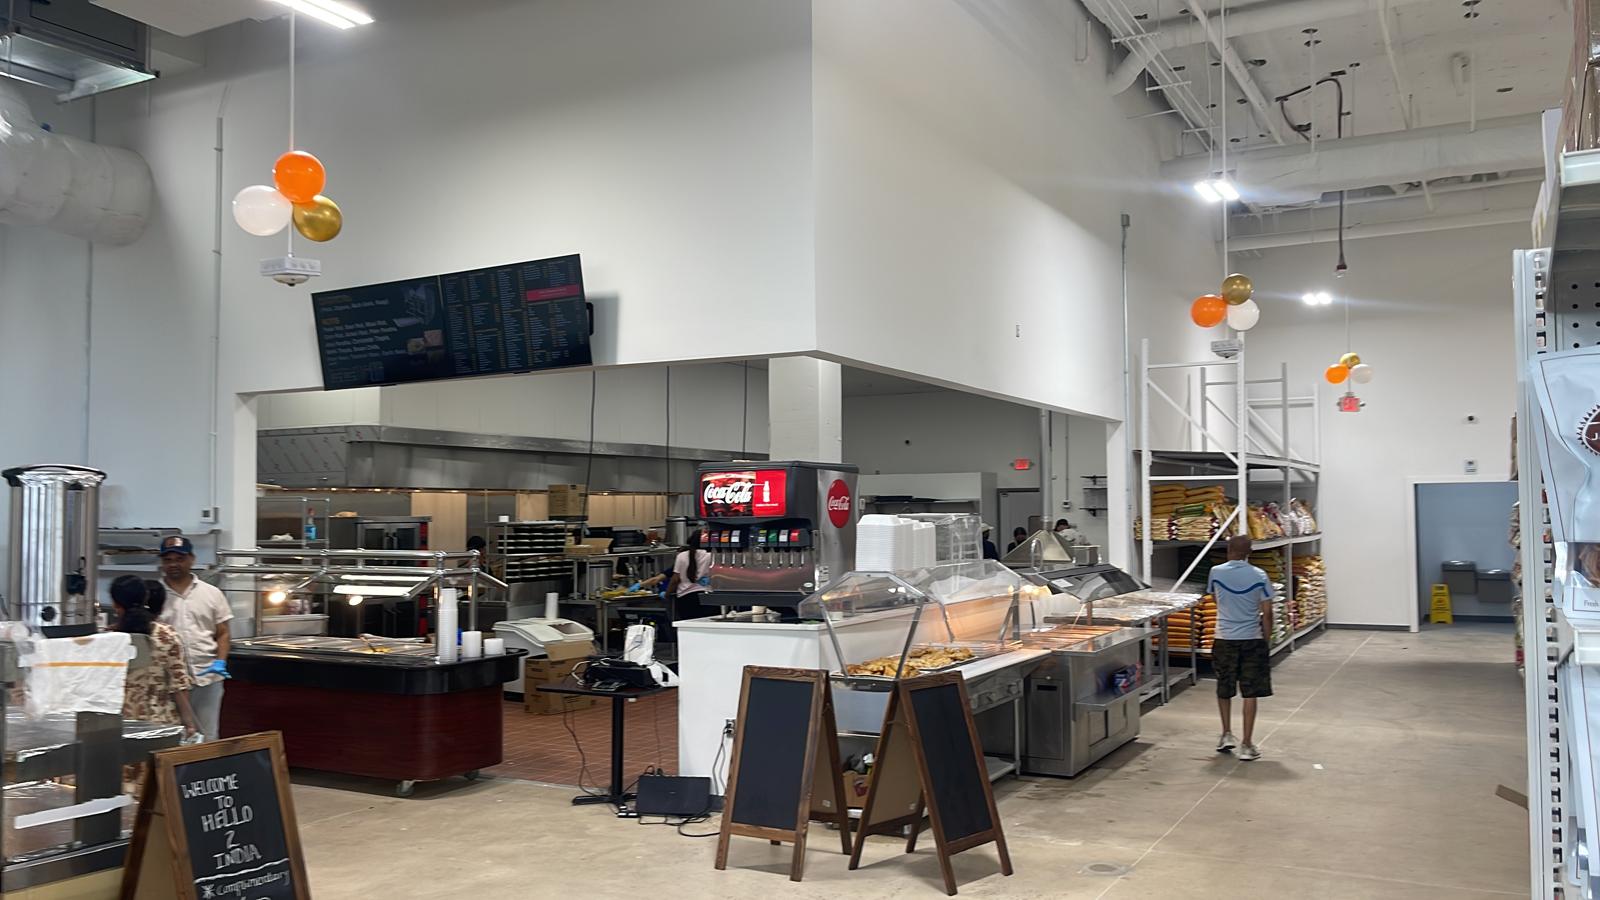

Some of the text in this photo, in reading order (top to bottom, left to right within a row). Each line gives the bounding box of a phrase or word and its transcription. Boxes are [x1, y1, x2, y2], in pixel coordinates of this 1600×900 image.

[704, 481, 753, 504] Coca-Cola
[181, 773, 239, 799] WELCOME
[201, 805, 254, 832] HELLO
[224, 830, 241, 849] 2
[212, 844, 262, 869] INDIA
